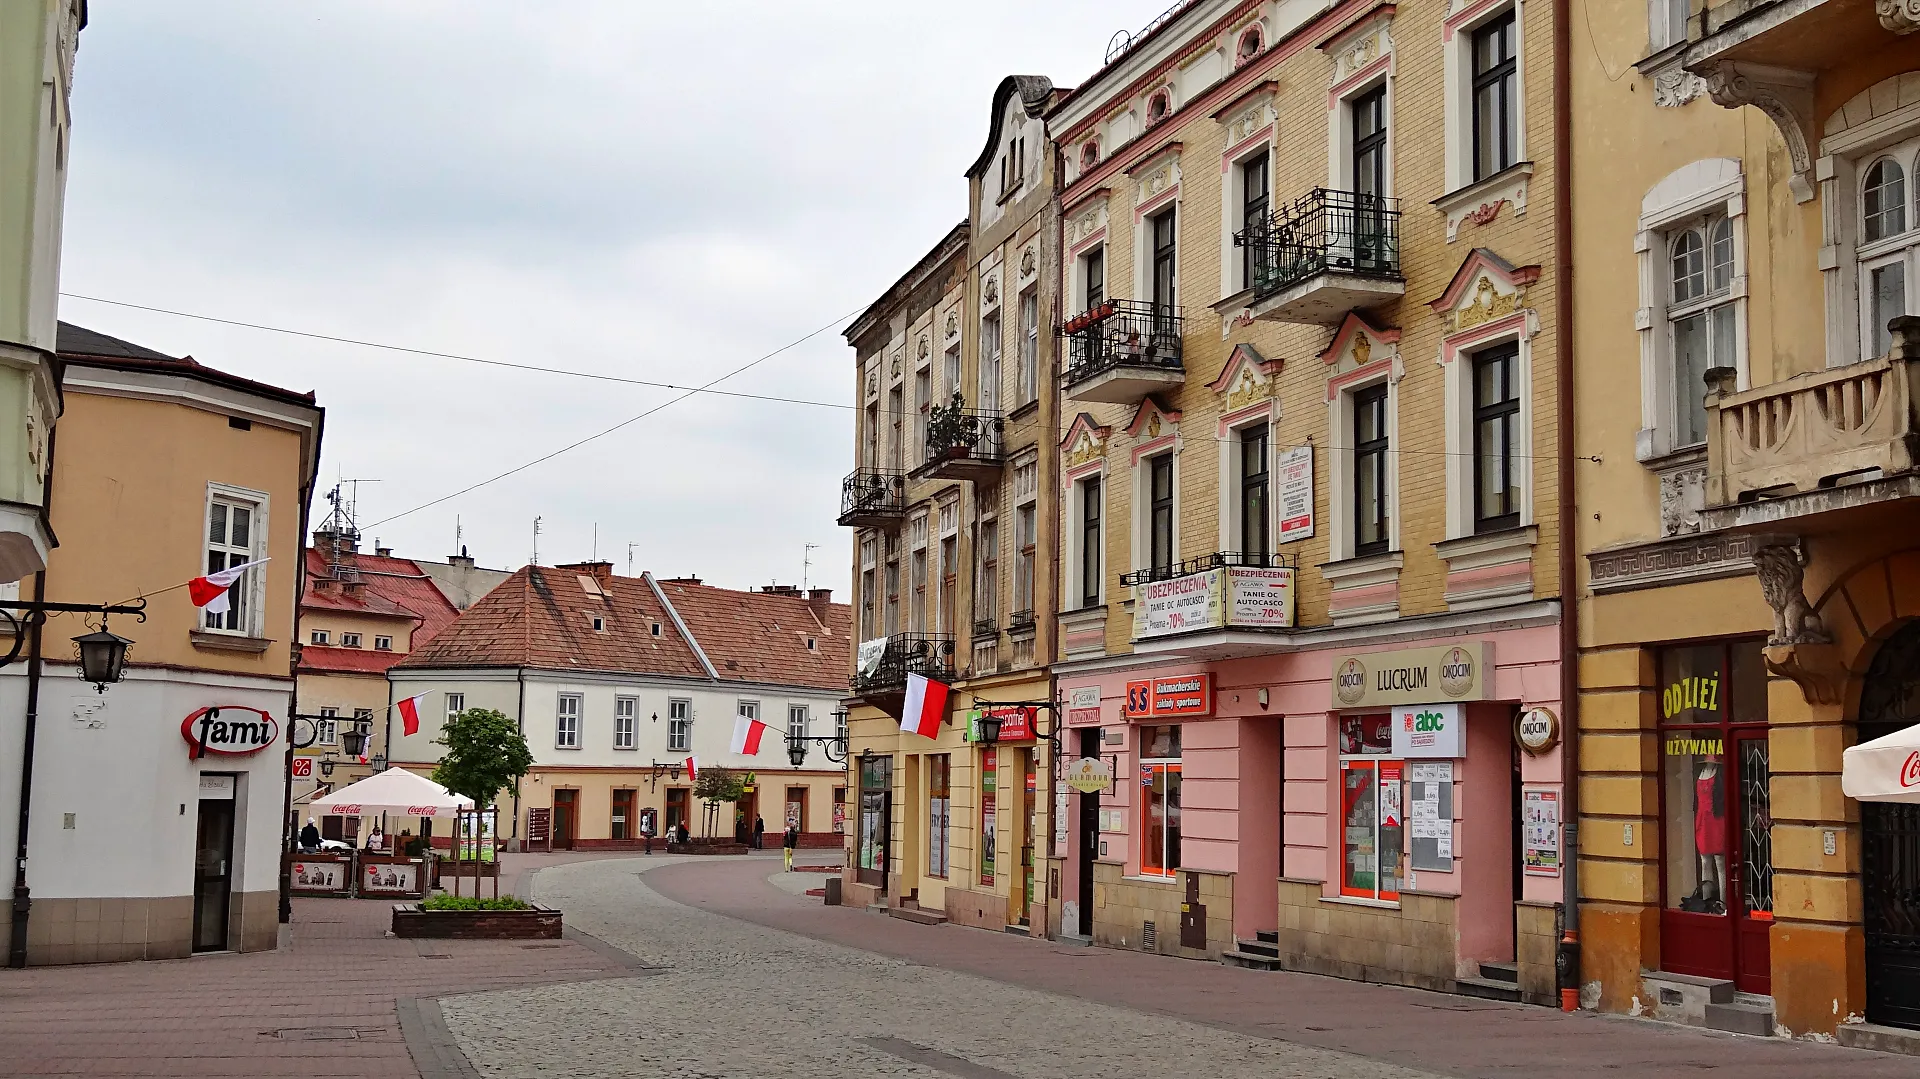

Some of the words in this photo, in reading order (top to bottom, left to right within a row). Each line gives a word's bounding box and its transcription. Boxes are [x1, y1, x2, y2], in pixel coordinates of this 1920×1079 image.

[1229, 570, 1291, 579] UBEZPIECZENIA
[1147, 576, 1207, 600] UBEZPIECZENIA
[1150, 602, 1165, 612] TANIE
[1167, 600, 1175, 609] OC
[1177, 596, 1205, 607] AUTOCASCO
[1236, 599, 1284, 607] AUTOCASCO
[1258, 609, 1284, 618] -70%
[1376, 667, 1428, 692] LUCRUM
[1442, 663, 1470, 680] OKOCIM
[1156, 679, 1201, 694] Bukmacherskie
[1339, 673, 1364, 688] OKOCIM
[1663, 671, 1718, 719] ODZIEŻ
[1176, 698, 1201, 709] sportowe
[1416, 710, 1444, 732] abc
[200, 707, 270, 758] fami
[1522, 723, 1547, 738] OKOCIM
[1666, 735, 1724, 755] UŻYWANA
[1900, 751, 1920, 788] Co
